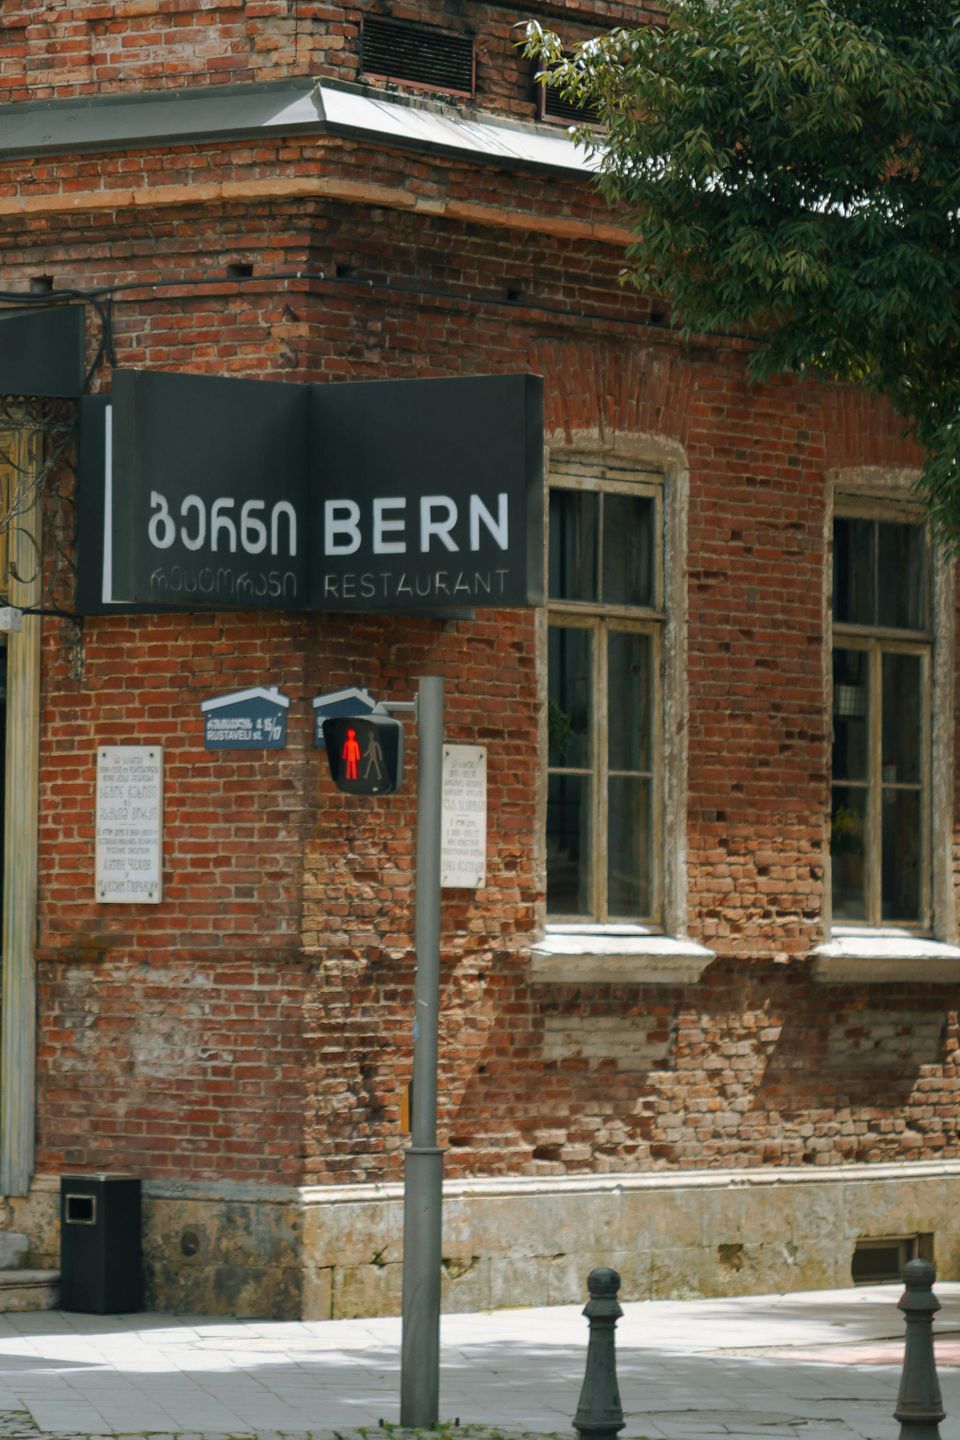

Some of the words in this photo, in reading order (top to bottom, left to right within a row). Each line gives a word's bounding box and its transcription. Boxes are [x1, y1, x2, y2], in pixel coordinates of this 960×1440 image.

[148, 490, 297, 556] ბერნი
[324, 493, 509, 556] BERN
[324, 569, 510, 599] RESTAURANT
[207, 730, 251, 741] RUSTAVELI
